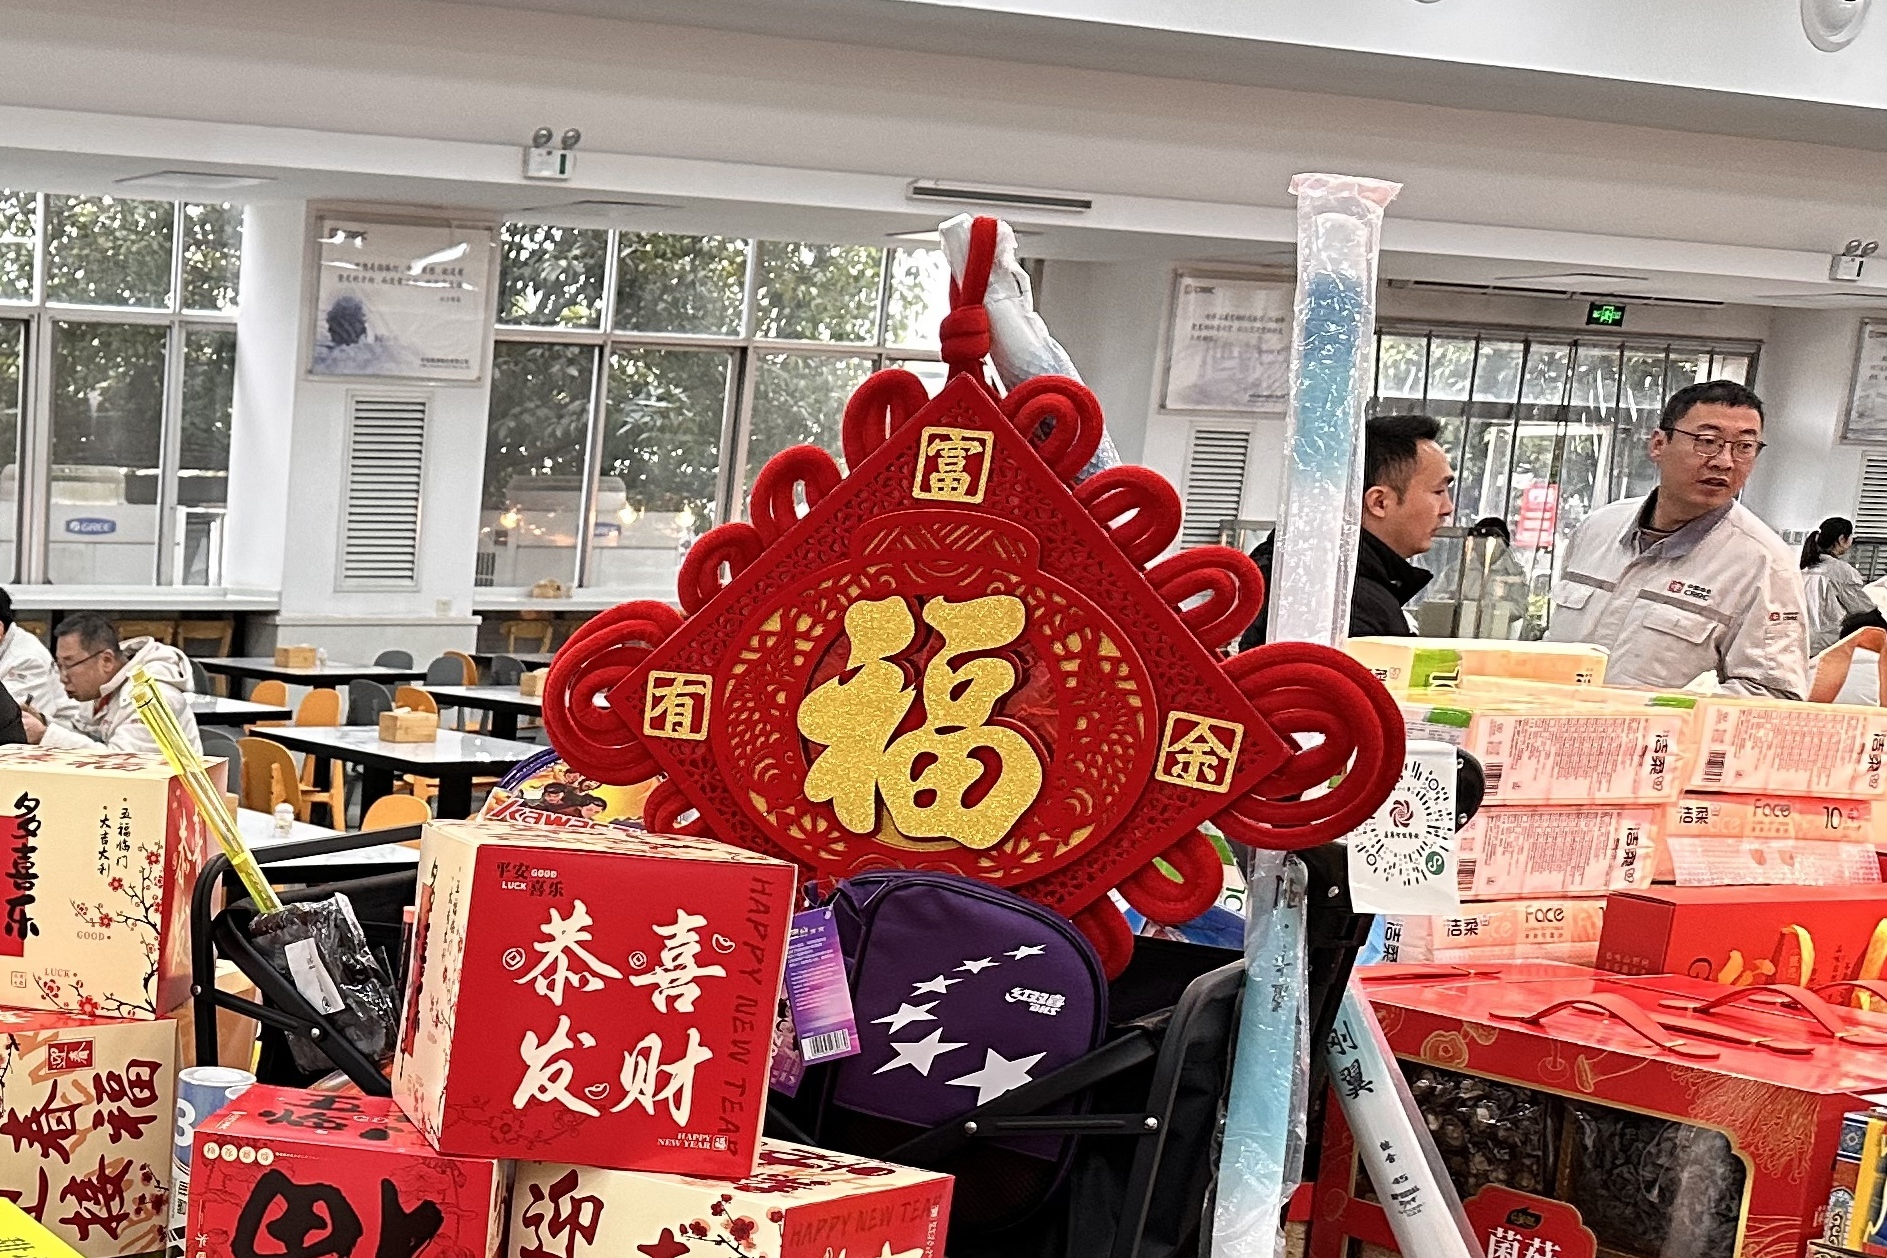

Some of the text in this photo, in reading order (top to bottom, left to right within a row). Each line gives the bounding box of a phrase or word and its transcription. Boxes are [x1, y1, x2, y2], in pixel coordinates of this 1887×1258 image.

[797, 595, 1043, 850] 福
[1752, 798, 1792, 818] Face
[530, 868, 558, 879] GOOD
[501, 880, 527, 891] LUCK
[1524, 904, 1565, 924] Face
[512, 898, 727, 1015] 恭喜
[511, 1014, 714, 1128] 发财
[657, 1138, 712, 1151] NEW YEAR
[677, 1132, 712, 1142] HAPPY
